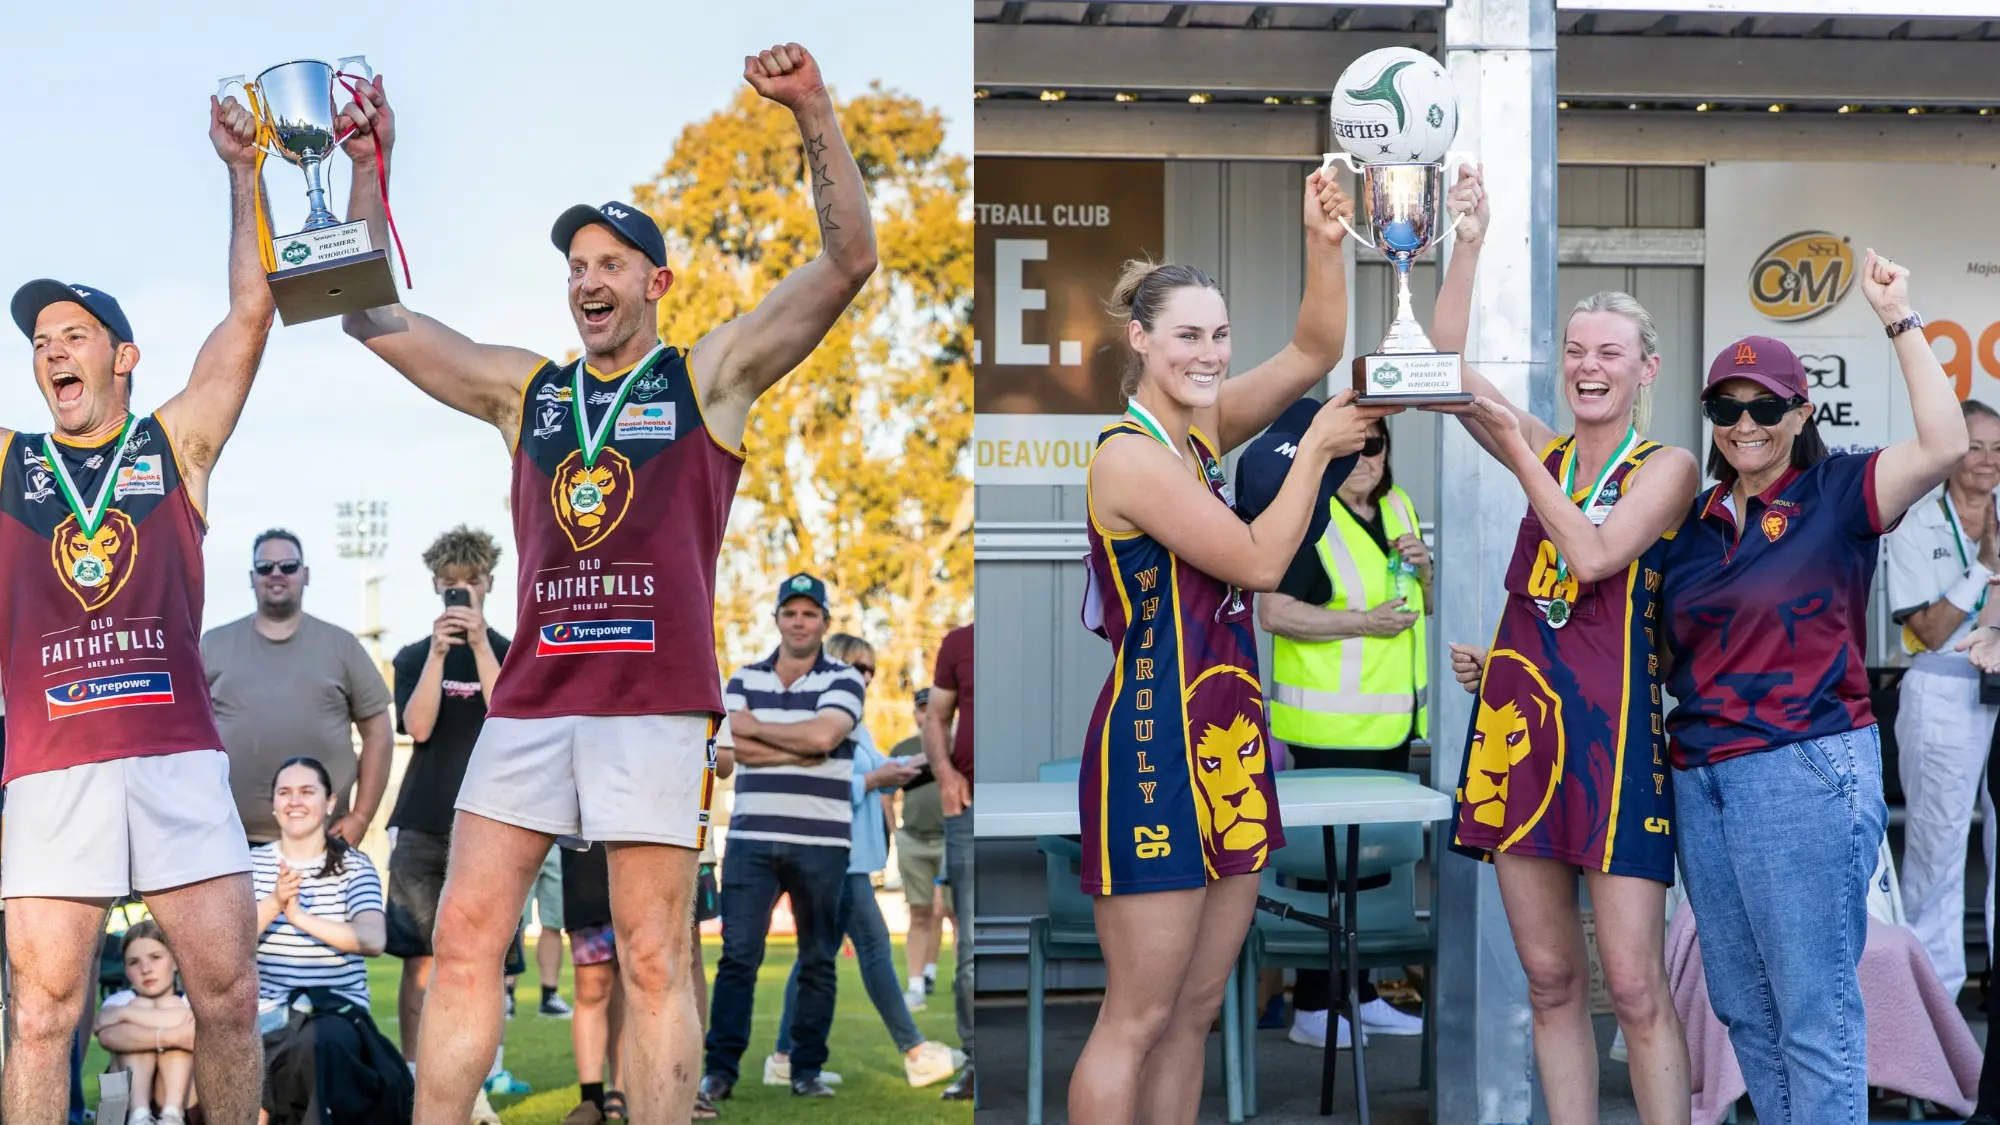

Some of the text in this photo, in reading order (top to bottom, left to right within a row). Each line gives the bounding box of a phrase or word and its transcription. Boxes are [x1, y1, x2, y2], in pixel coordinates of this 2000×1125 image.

[974, 204, 1110, 227] TBALL CLUB
[313, 233, 337, 242] Seniors
[341, 227, 358, 237] 2026
[319, 238, 356, 251] PREMIERS
[286, 247, 307, 259] O&K
[317, 246, 360, 260] WHOROULY
[1753, 259, 1843, 304] O&M
[1735, 343, 1757, 366] LA
[1377, 372, 1398, 380] O&K
[579, 558, 601, 571] OLD
[573, 602, 608, 611] BREW BAR
[90, 617, 113, 631] OLD
[572, 626, 632, 639] Tyrepower
[87, 657, 124, 669] BREW BAR
[88, 679, 151, 695] Tyrepower
[1644, 816, 1670, 835] 5
[1134, 824, 1171, 859] 26
